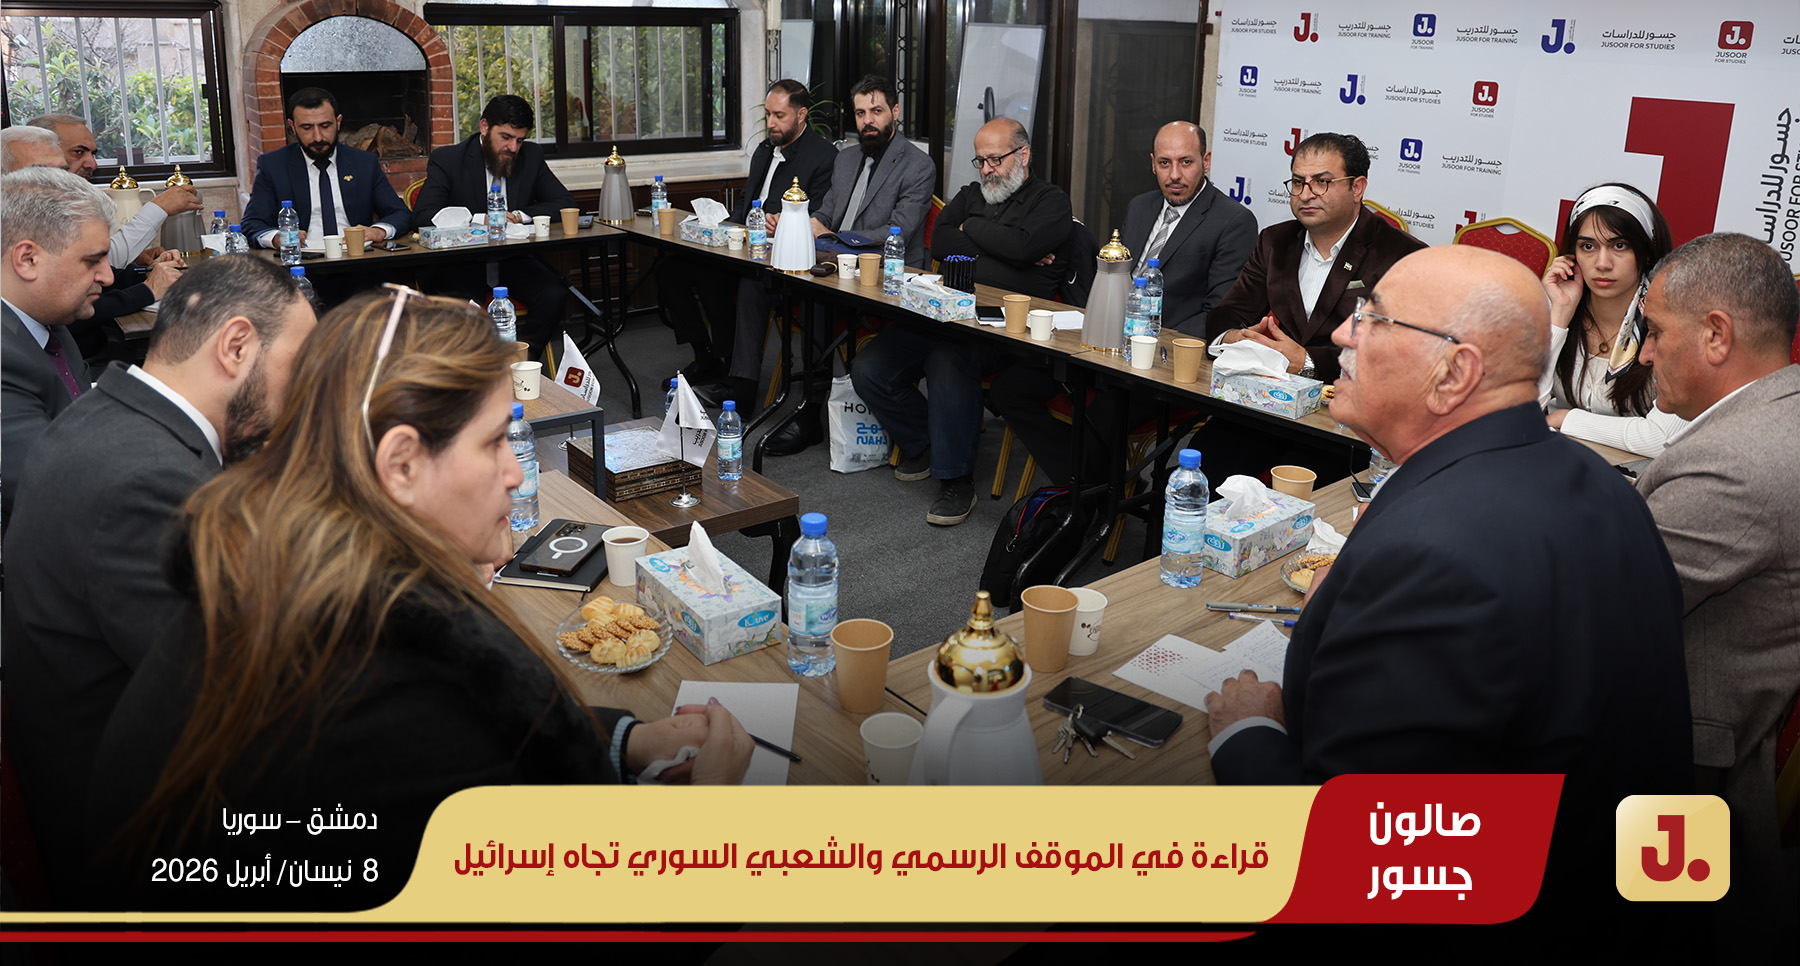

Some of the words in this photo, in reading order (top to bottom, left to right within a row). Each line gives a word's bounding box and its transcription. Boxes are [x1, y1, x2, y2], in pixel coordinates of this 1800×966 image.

[1232, 18, 1258, 26] للدراسات
[1338, 22, 1366, 31] للتدريب
[1366, 24, 1391, 32] جسور
[1457, 25, 1489, 35] للتدريب
[1490, 28, 1518, 37] جسور
[1602, 30, 1645, 40] للدراسات
[1646, 32, 1676, 42] جسور
[1274, 78, 1299, 86] للتدريب
[1300, 80, 1322, 89] جسور
[1386, 84, 1418, 94] للدراسات
[1418, 88, 1442, 97] جسور
[1224, 128, 1250, 137] للدراسات
[1250, 132, 1268, 140] جسور
[1284, 128, 1301, 156] J
[1769, 108, 1800, 174] جسور
[1442, 154, 1474, 164] للتدريب
[1474, 158, 1502, 168] جسور
[1476, 167, 1502, 175] TRAINING
[1755, 174, 1784, 244] للدراس
[1414, 210, 1435, 222] جسور
[1412, 220, 1434, 229] STUDIES
[1780, 208, 1800, 261] USOOR
